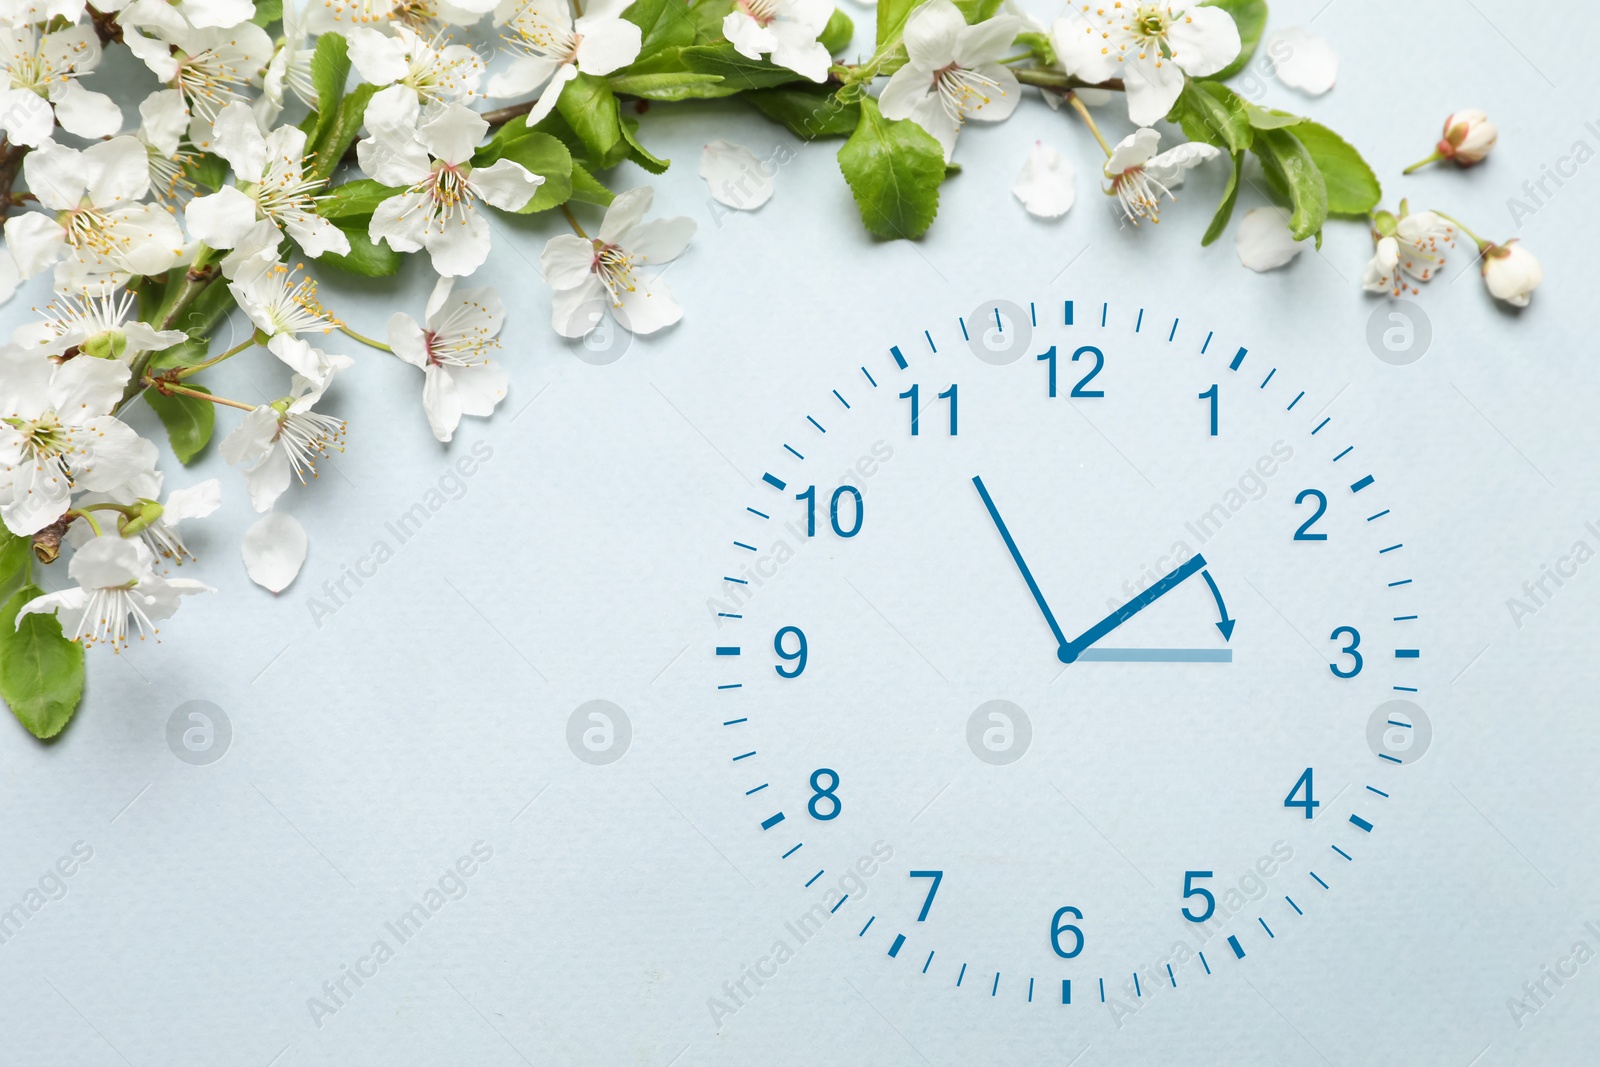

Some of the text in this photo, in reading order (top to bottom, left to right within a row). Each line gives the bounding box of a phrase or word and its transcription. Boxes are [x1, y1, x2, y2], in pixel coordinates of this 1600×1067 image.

[1036, 344, 1106, 399] 12
[899, 383, 958, 436] 11
[1198, 383, 1218, 436] 1
[795, 485, 864, 538] 10
[1293, 488, 1328, 541] 2
[773, 625, 808, 679] 9
[1329, 625, 1364, 679] 3
[807, 768, 842, 821] 8
[1283, 767, 1320, 820] 4
[909, 870, 943, 922] 7
[1181, 870, 1216, 923] 5
[1050, 905, 1085, 959] 6
